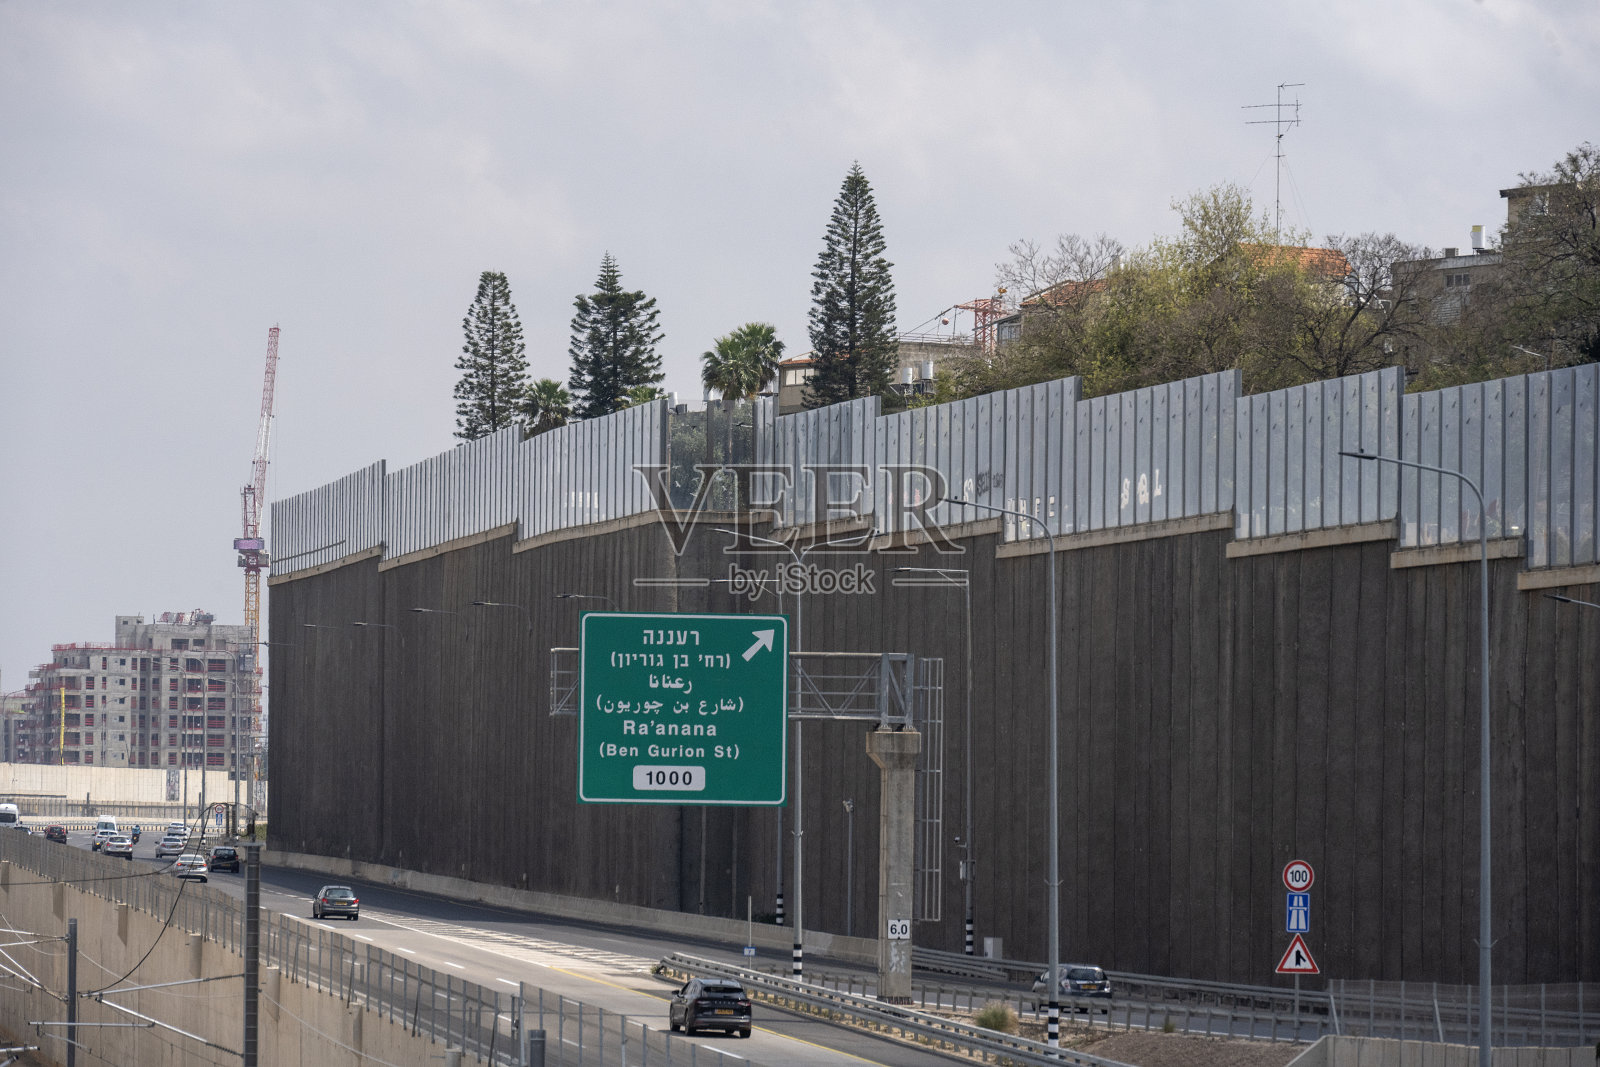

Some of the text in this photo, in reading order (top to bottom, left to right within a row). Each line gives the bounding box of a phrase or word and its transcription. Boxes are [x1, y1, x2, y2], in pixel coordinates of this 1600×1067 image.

[643, 629, 700, 645] רעננה
[611, 651, 664, 668] גוריון)
[673, 653, 689, 669] בן
[649, 673, 693, 694] رعنانا
[673, 700, 689, 714] بن
[623, 719, 717, 736] Ra'anana
[599, 741, 740, 760] (Ben Gurion St)
[645, 770, 693, 786] 1000
[1289, 870, 1308, 883] 100
[890, 924, 908, 935] 6.0
